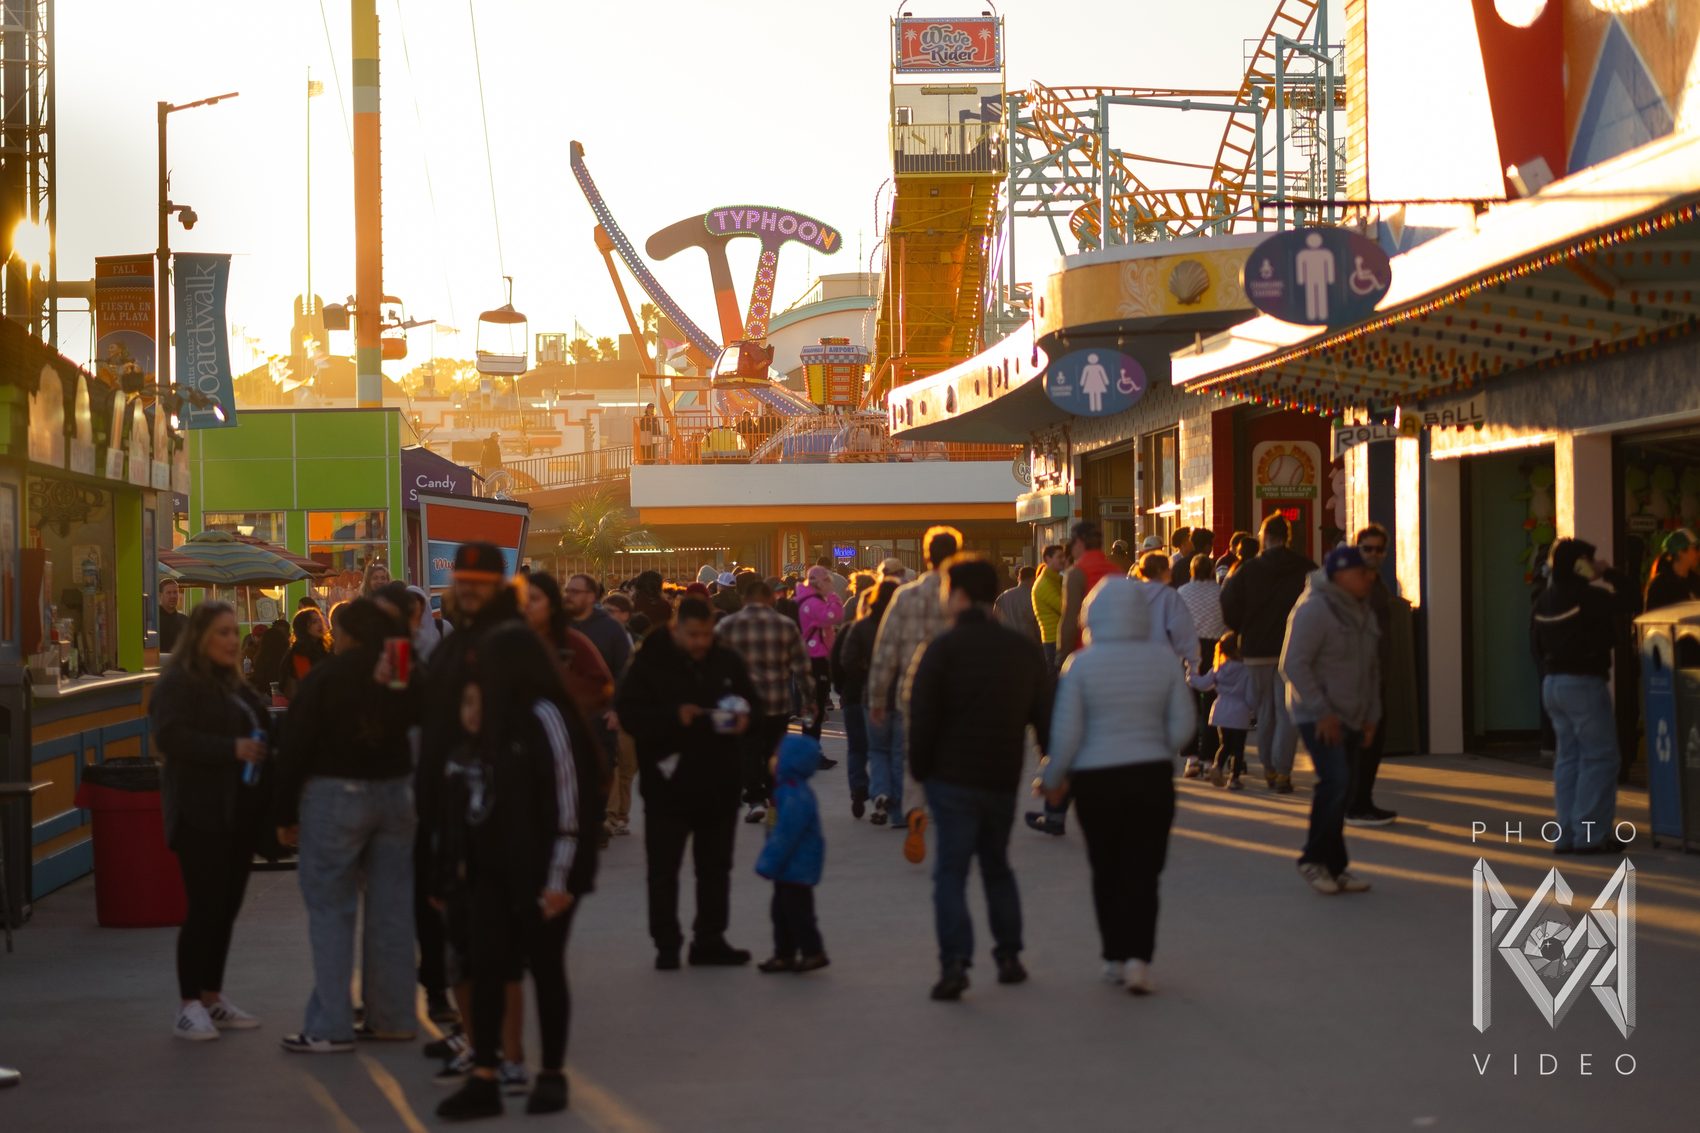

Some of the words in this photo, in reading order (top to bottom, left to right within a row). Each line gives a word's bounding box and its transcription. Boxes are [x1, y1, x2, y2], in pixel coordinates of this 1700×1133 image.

[921, 24, 971, 46] Wave
[921, 44, 976, 64] Rider
[713, 209, 837, 250] TYPHOON
[112, 264, 138, 274] FALL
[101, 302, 135, 311] FIESTA
[139, 302, 151, 311] EN
[103, 312, 116, 321] LA
[120, 312, 149, 321] PLAYA
[1336, 426, 1398, 453] ROLL
[1403, 416, 1416, 432] A
[1424, 401, 1483, 424] BALL
[416, 474, 456, 491] Candy
[833, 547, 856, 557] Modelo
